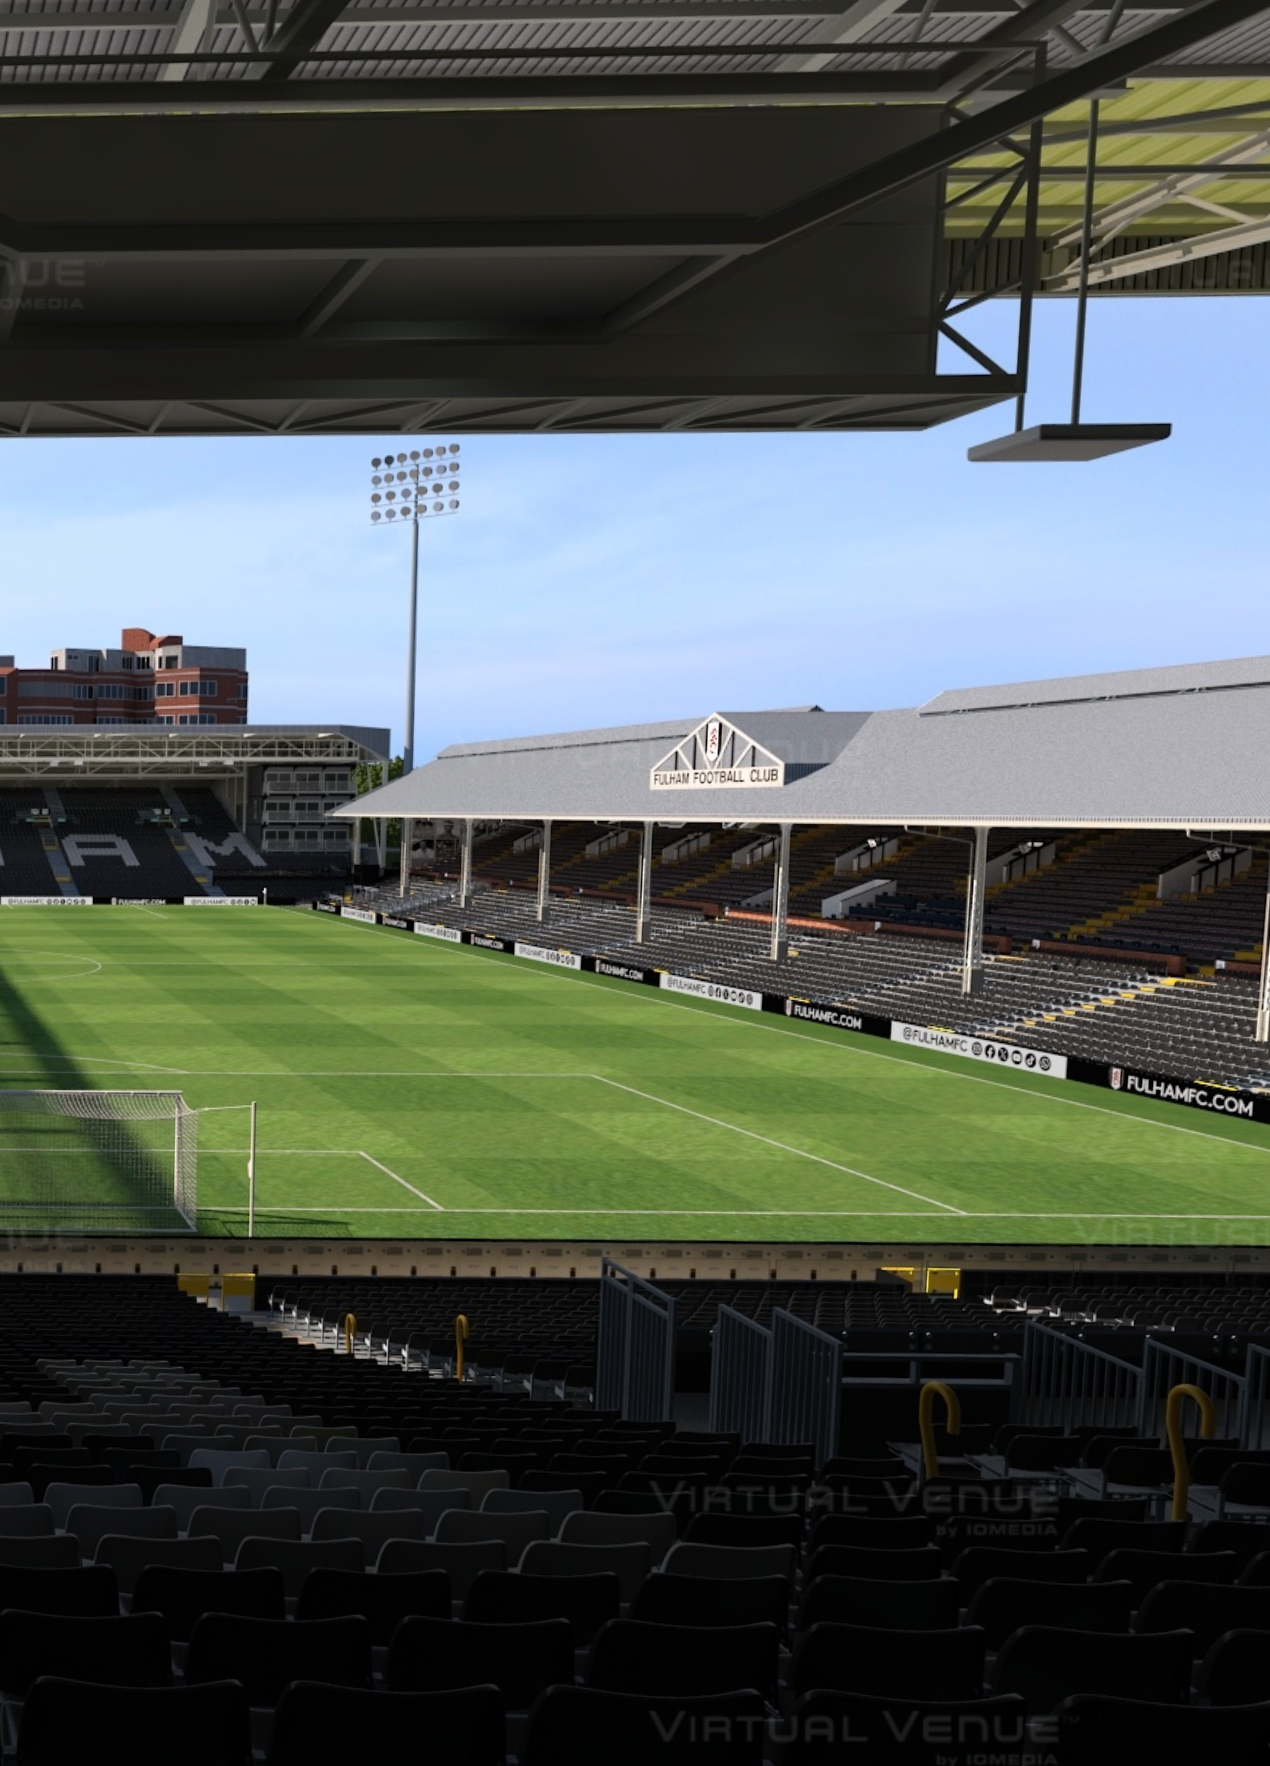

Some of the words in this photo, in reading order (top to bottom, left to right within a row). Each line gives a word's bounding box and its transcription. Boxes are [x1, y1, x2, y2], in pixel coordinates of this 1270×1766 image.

[653, 772, 689, 785] FULHAM
[693, 770, 745, 784] FOOTBALL
[750, 769, 779, 783] CLUB
[667, 976, 706, 994] @FULHAMFC
[793, 1006, 862, 1030] FULHAMFC.COM
[902, 1026, 968, 1053] @FULHAMFC
[1126, 1075, 1254, 1117] FULHAMFC.COM
